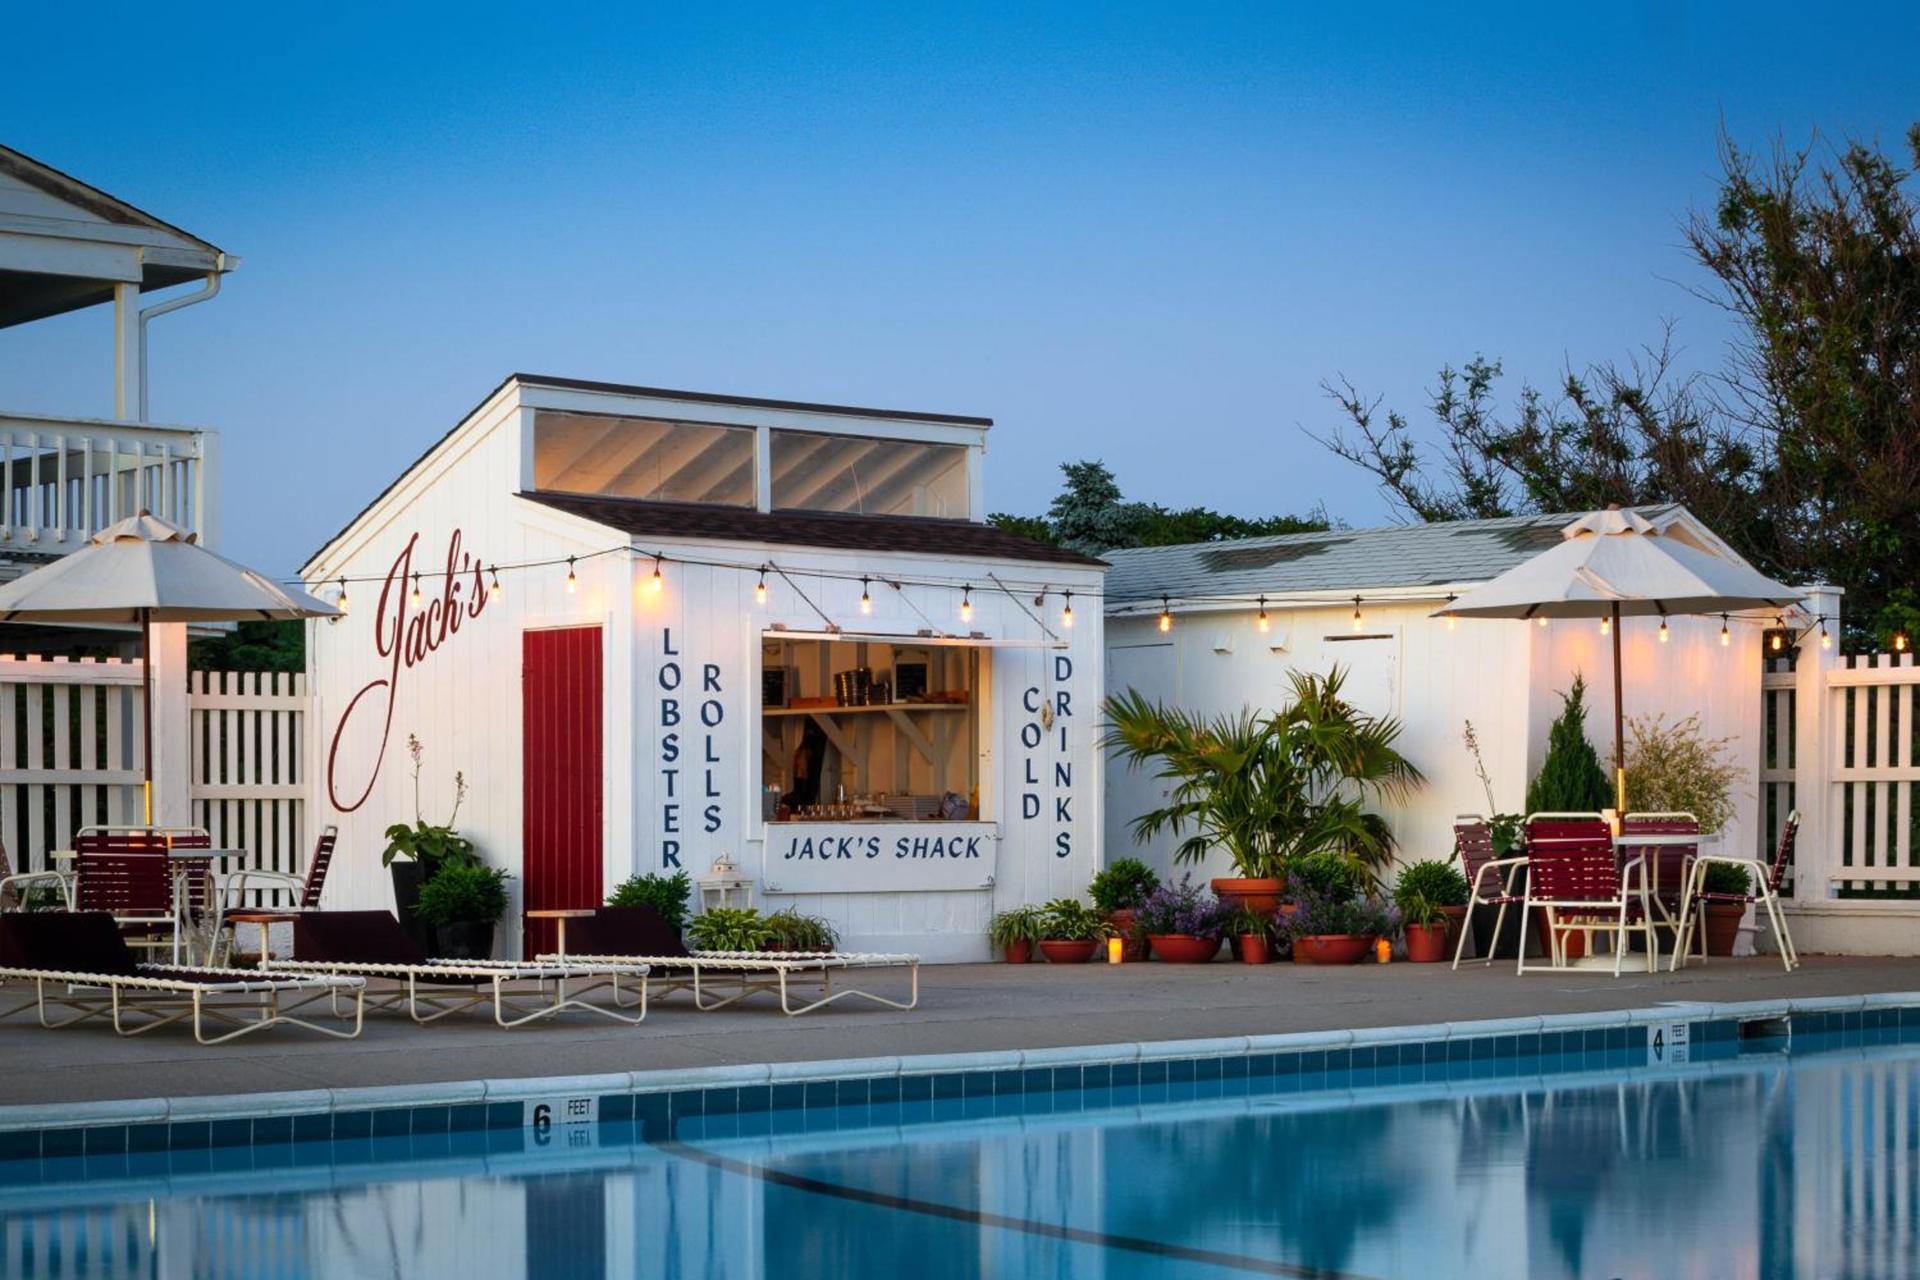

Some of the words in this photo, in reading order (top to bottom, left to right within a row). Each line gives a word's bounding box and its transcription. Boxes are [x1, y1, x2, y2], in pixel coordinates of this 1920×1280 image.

[328, 528, 488, 813] Jack's
[658, 627, 682, 869] LOBSTER
[700, 664, 724, 833] ROLLS
[1021, 687, 1042, 820] COLD
[1055, 656, 1073, 858] DRINKS
[784, 836, 881, 860] JACK'S
[895, 836, 981, 859] SHACK
[1653, 1028, 1664, 1046] 4
[1671, 1024, 1685, 1037] FEET
[533, 1104, 551, 1126] 6
[567, 1098, 591, 1115] FEET
